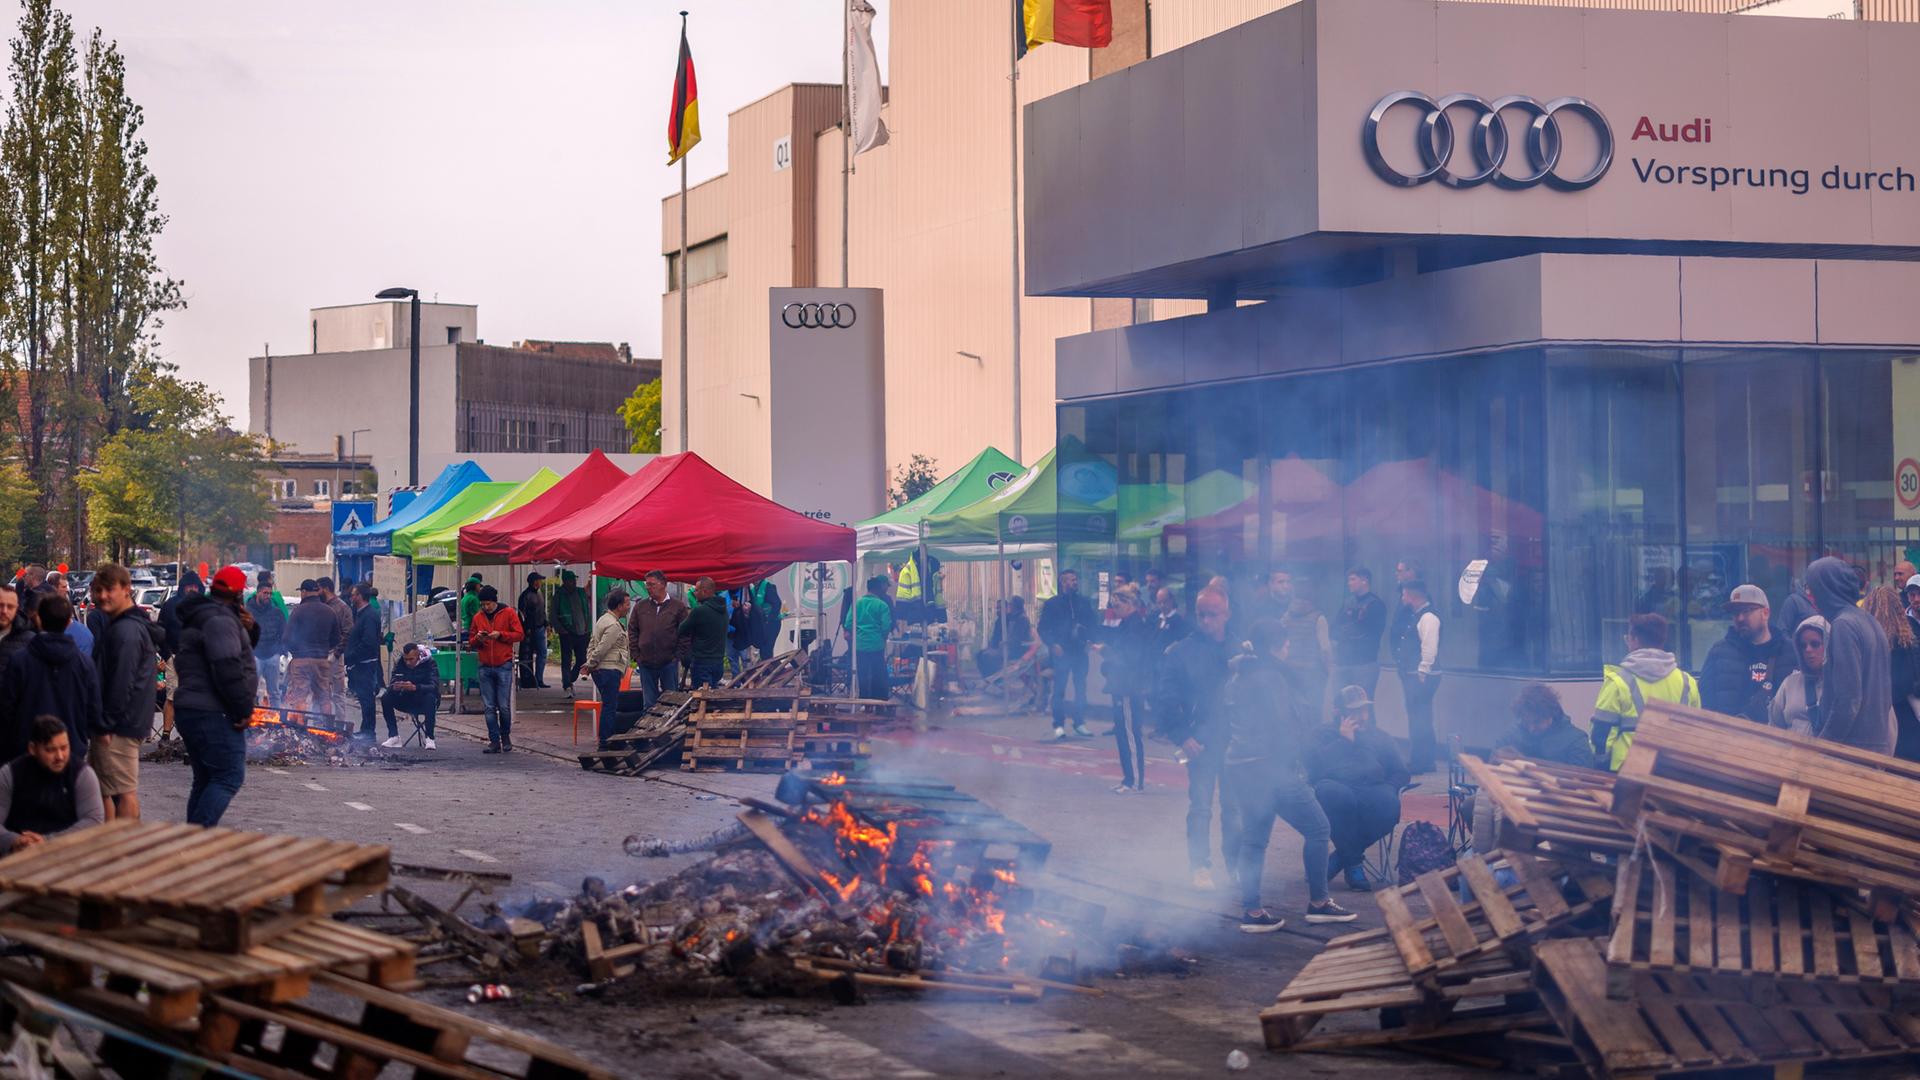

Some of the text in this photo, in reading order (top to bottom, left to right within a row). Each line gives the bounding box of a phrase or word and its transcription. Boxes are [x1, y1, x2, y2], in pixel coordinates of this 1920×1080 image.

[1631, 116, 1711, 143] Audi
[777, 142, 789, 168] Q1
[1631, 158, 1915, 195] Vorsprung durch
[1901, 473, 1917, 491] 30
[801, 509, 831, 519] trée
